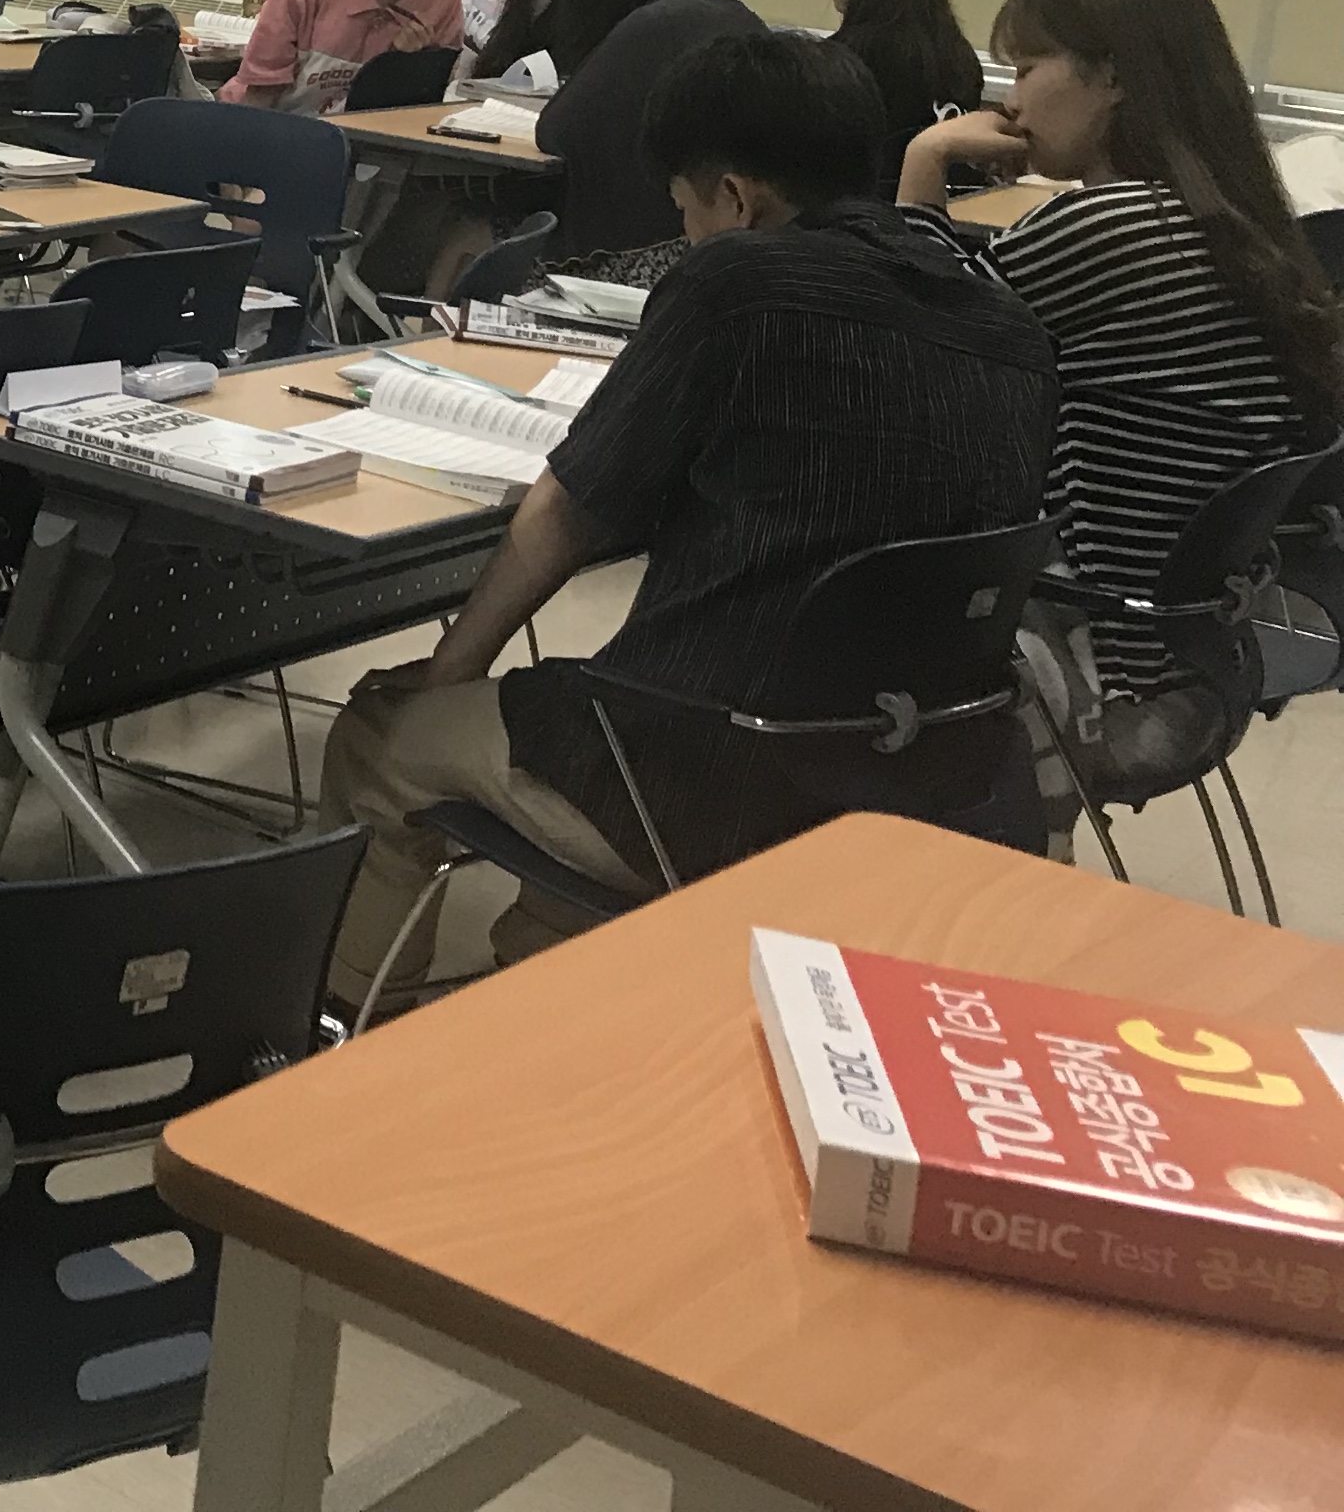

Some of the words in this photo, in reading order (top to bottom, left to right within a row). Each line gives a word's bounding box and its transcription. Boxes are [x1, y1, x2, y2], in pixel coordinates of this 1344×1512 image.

[306, 69, 355, 87] GOOD
[920, 980, 1008, 1046] Test
[822, 1042, 884, 1103] TOEIC
[1116, 1018, 1305, 1109] LC
[942, 1044, 1065, 1165] TOEIC
[1035, 1031, 1196, 1192] 공식종합서
[867, 1156, 896, 1217] TOEIC
[945, 1199, 1084, 1260] TOEIC
[1094, 1229, 1180, 1278] Test
